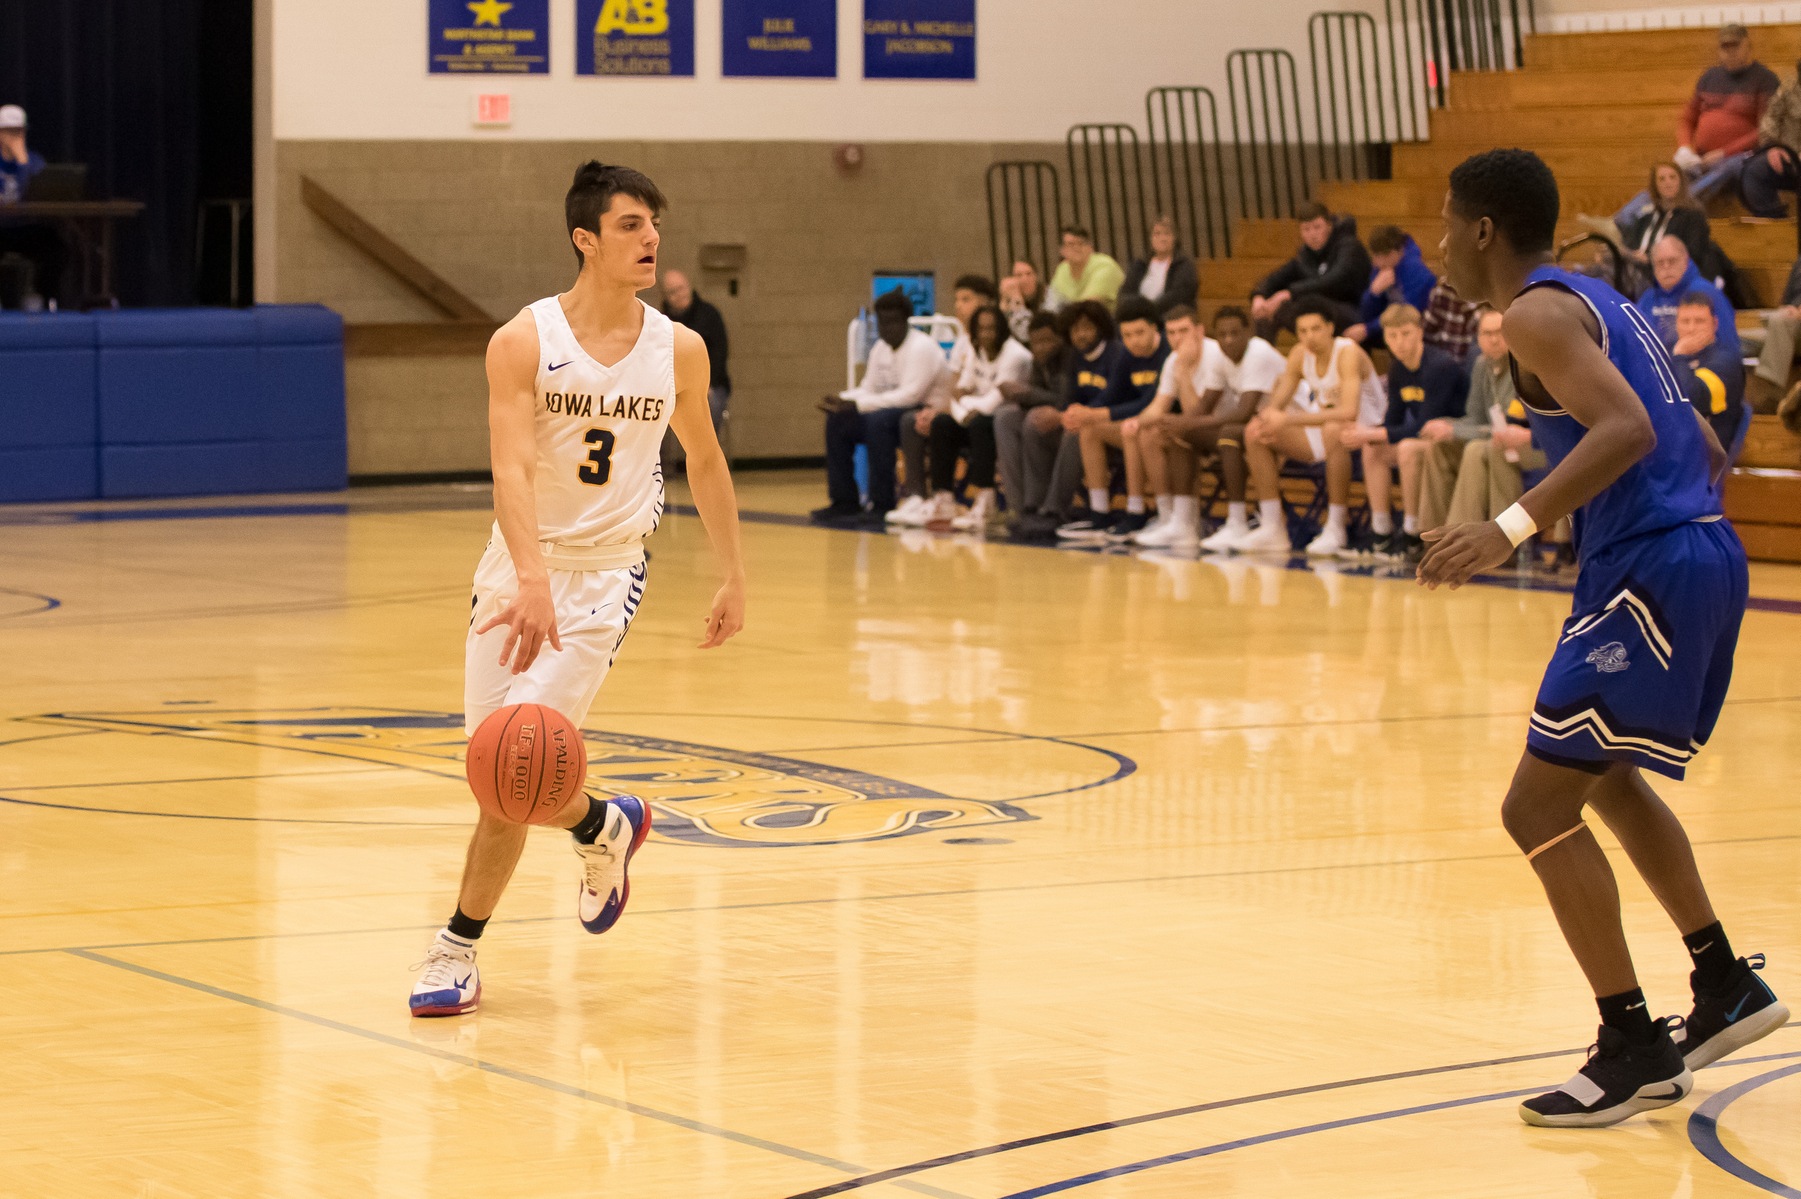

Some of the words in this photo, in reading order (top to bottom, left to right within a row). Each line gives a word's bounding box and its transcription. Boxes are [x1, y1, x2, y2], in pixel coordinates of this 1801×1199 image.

[594, 36, 671, 55] Business
[594, 56, 671, 75] Solutions
[545, 392, 592, 417] IOWA
[600, 395, 664, 421] LAKES
[576, 426, 617, 488] 3
[542, 727, 568, 807] SPALDING
